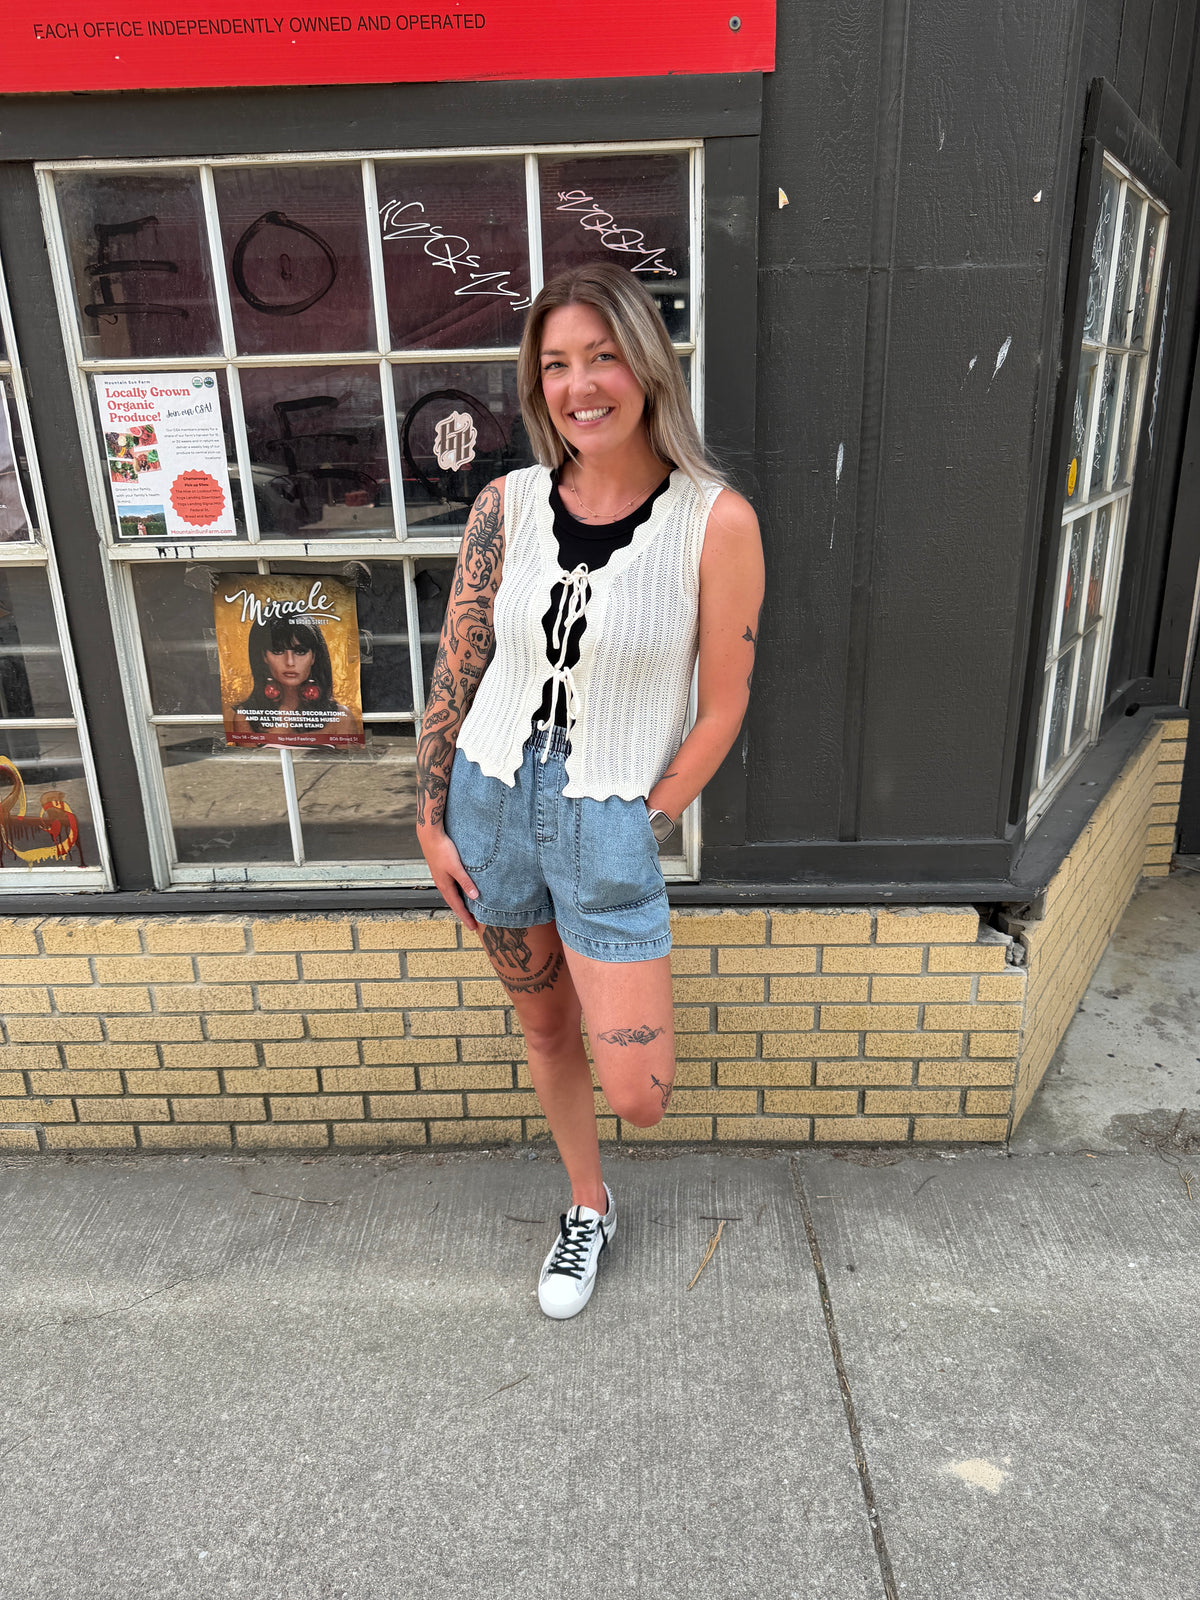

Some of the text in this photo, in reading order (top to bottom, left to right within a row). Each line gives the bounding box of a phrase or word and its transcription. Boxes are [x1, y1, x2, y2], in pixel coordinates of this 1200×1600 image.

[34, 14, 486, 39] EACH OFFICE INDEPENDENTLY OWNED AND OPERATED
[105, 386, 191, 399] Locally Grown
[107, 400, 155, 412] Organic
[166, 410, 181, 418] Join
[194, 402, 213, 415] CSA!
[109, 412, 162, 423] Produce!
[224, 581, 335, 626] Miracle
